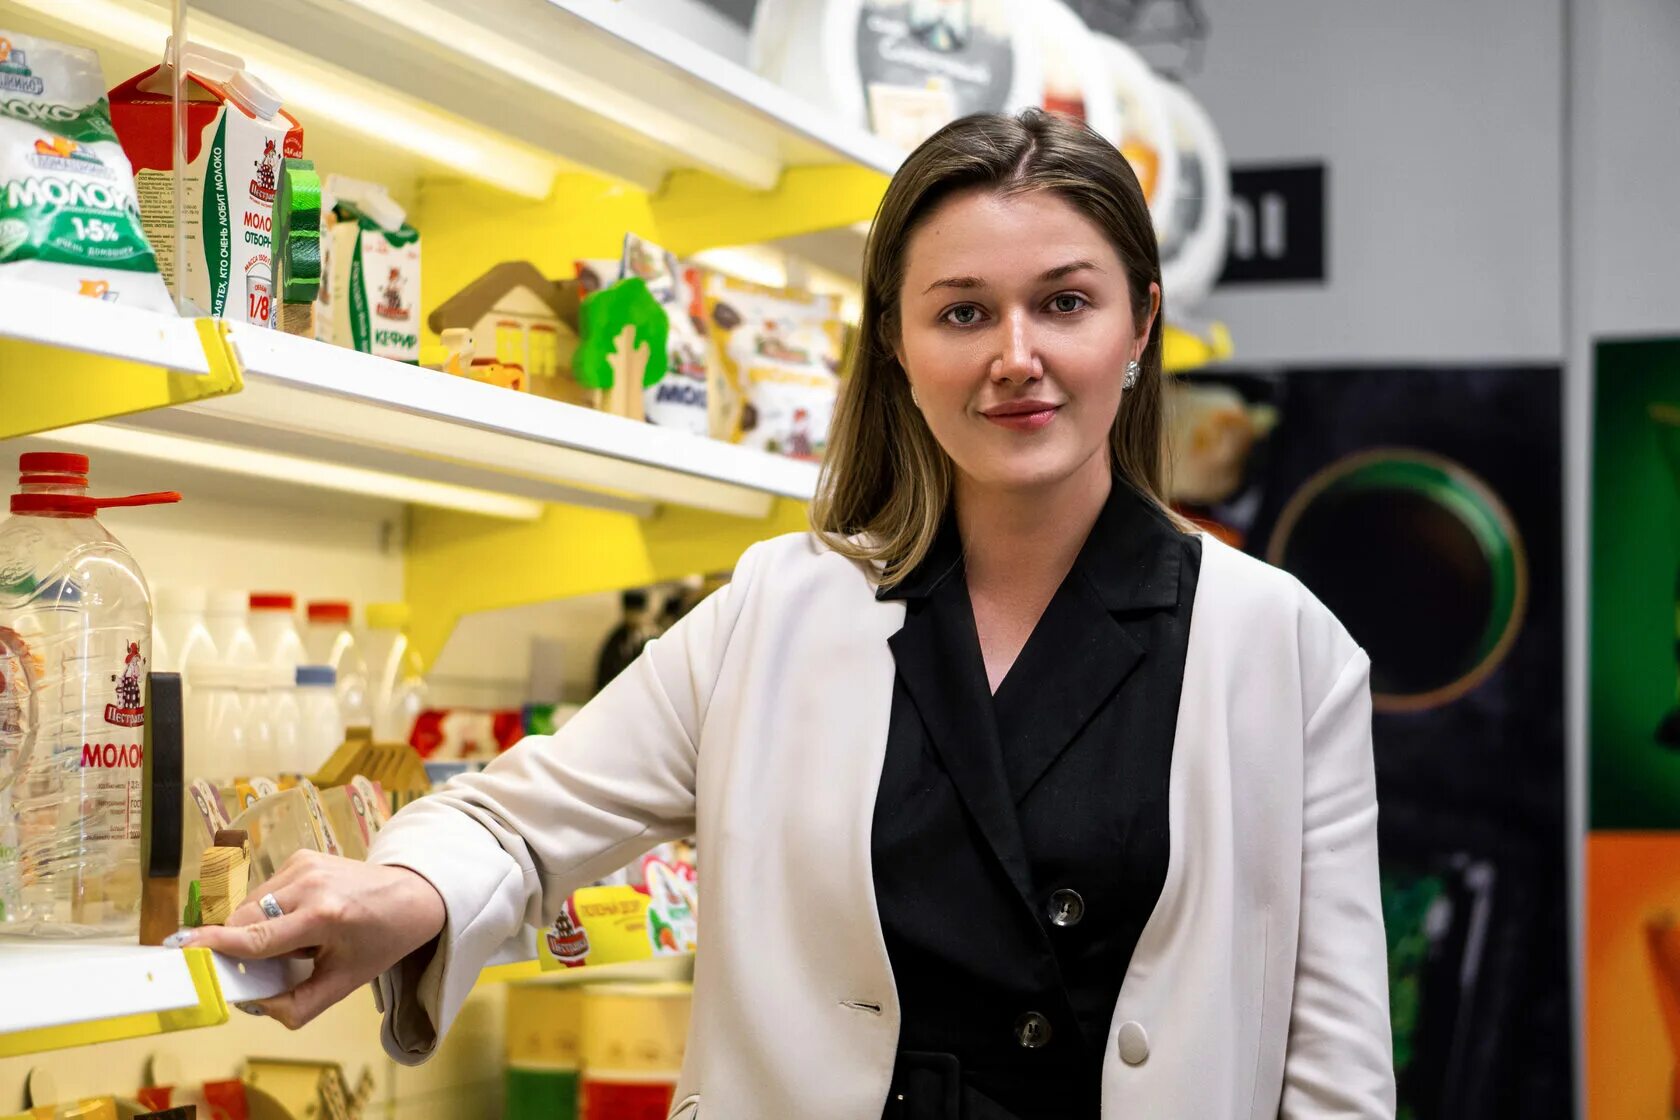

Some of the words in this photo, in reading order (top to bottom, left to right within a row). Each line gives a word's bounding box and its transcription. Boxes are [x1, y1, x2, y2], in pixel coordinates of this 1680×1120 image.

[213, 147, 225, 191] МОЛОКО
[215, 193, 228, 226] ЛЮБИТ
[244, 211, 272, 234] МОЛО
[219, 228, 229, 257] ОЧЕНЬ
[219, 260, 229, 278] КТО
[216, 281, 229, 299] ТЕХ,
[249, 293, 269, 321] 1/8
